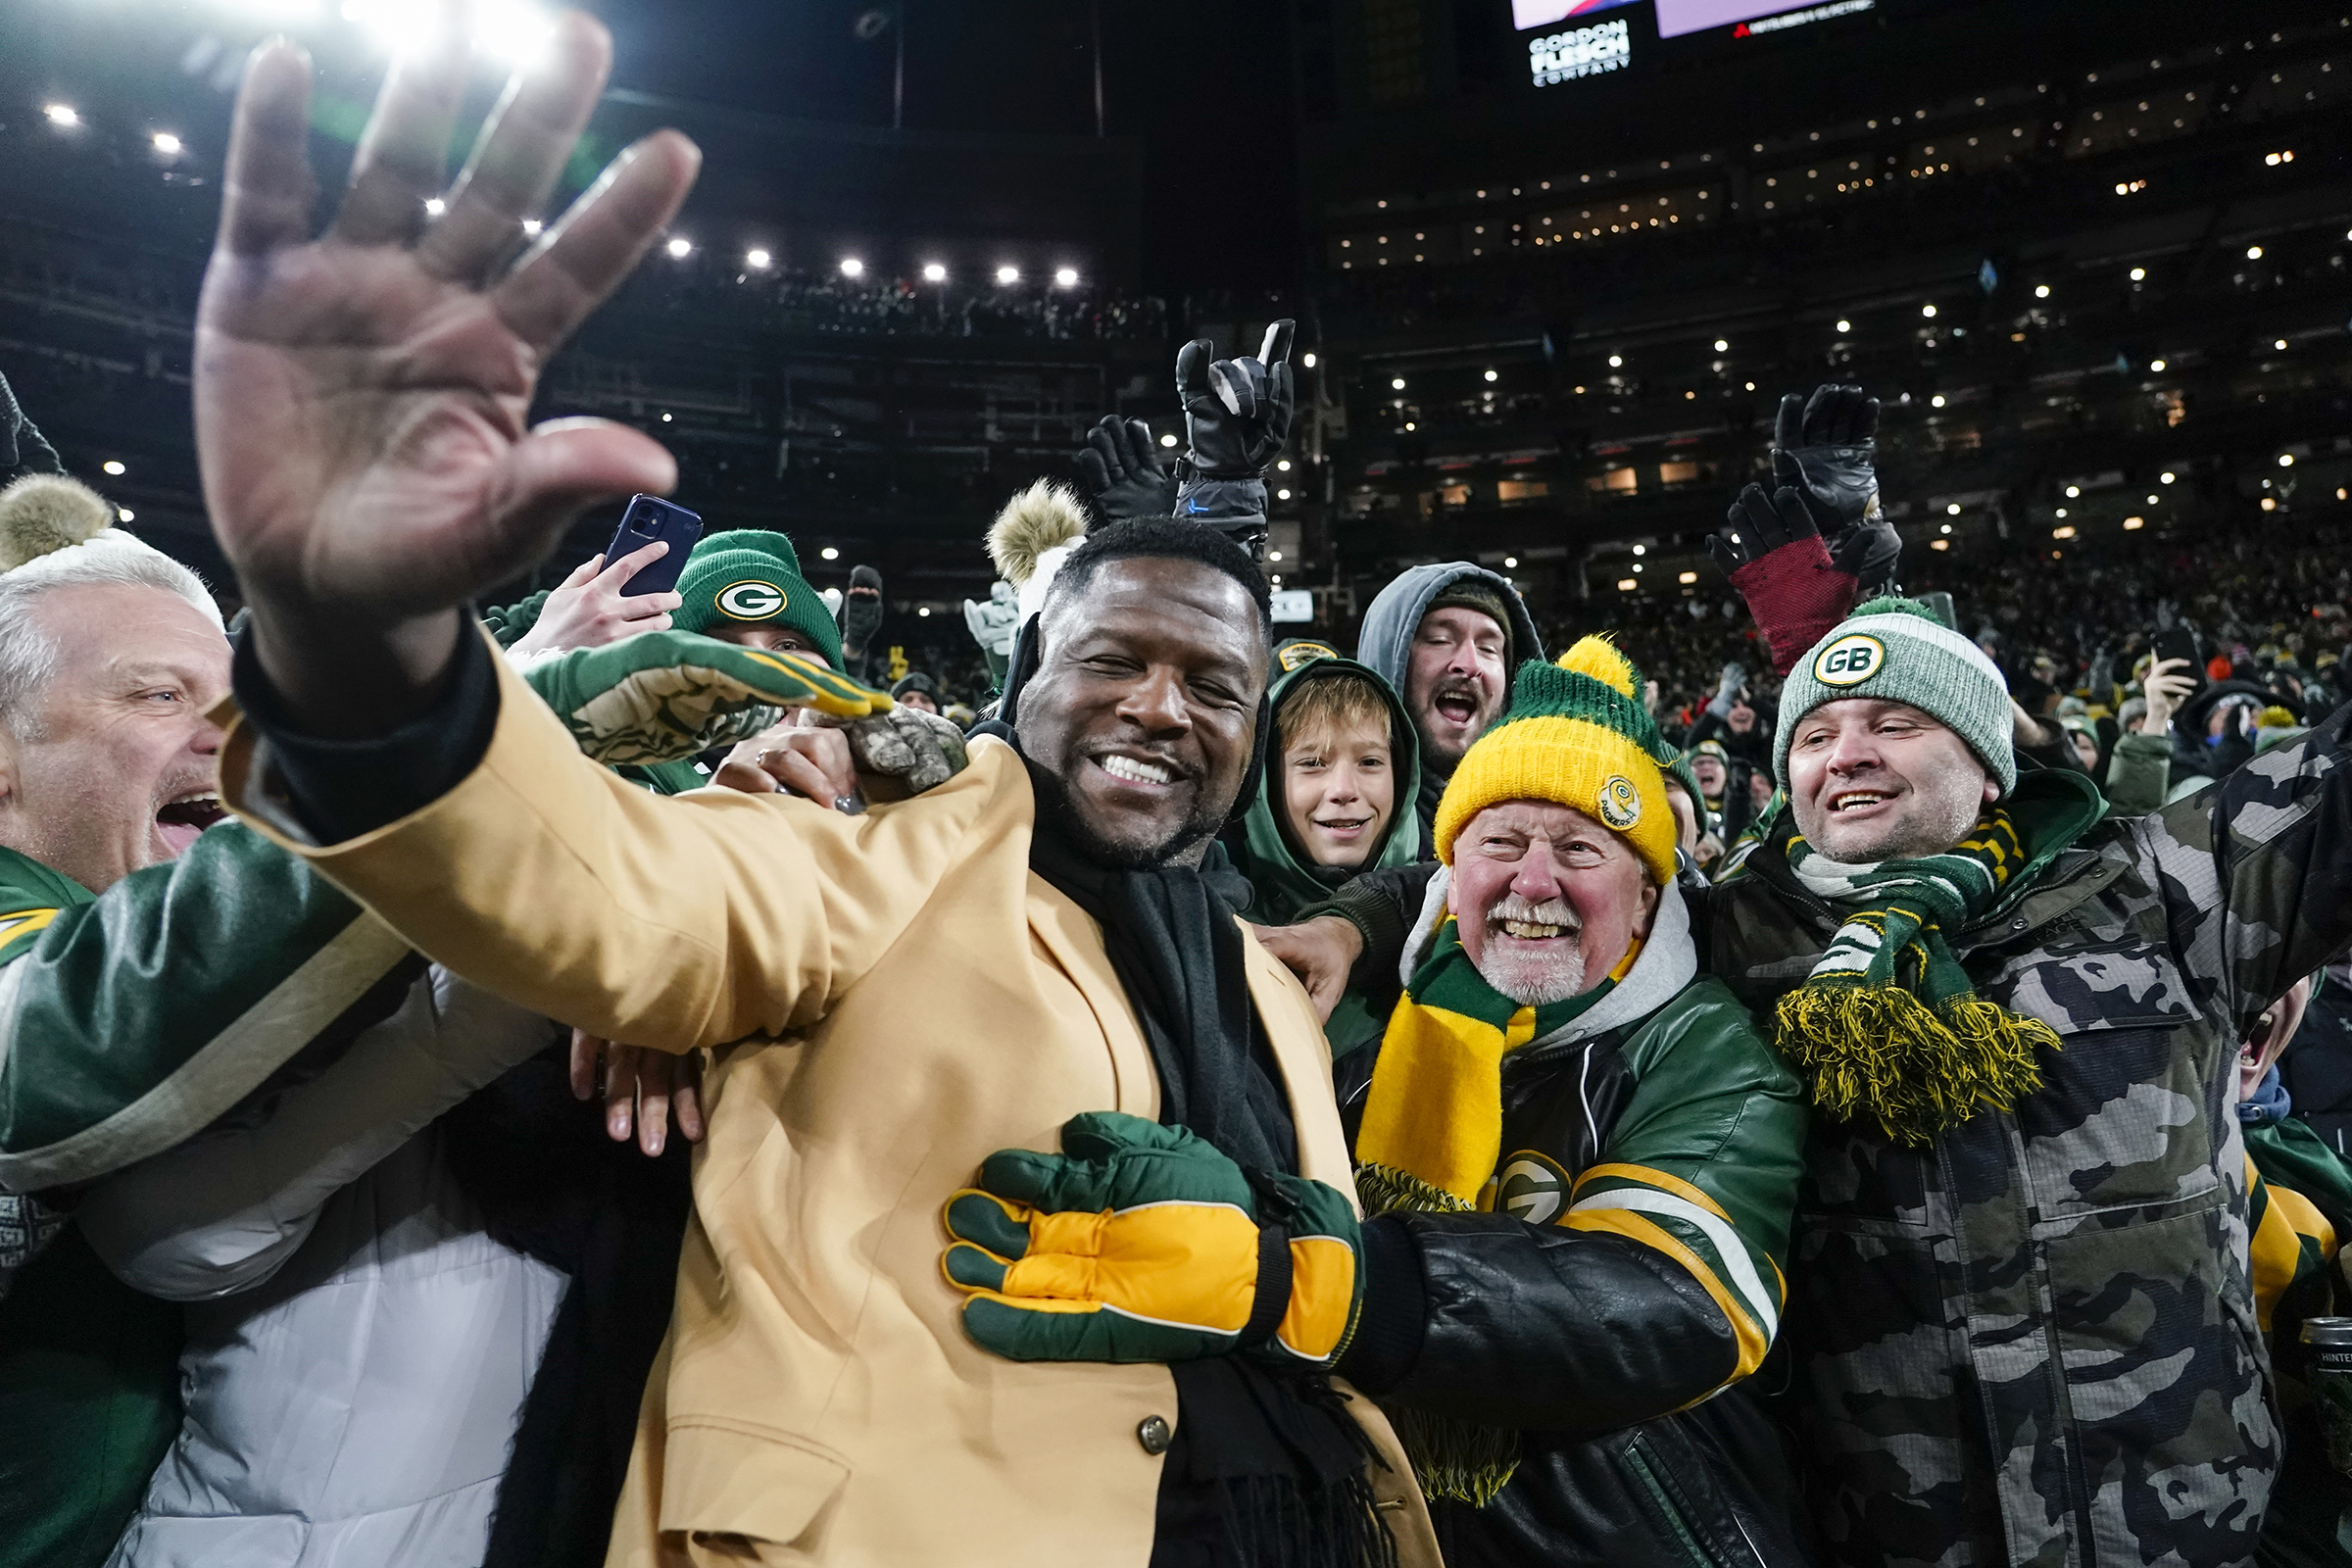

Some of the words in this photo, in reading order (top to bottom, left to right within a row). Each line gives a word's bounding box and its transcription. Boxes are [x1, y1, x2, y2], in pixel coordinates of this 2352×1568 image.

[1529, 19, 1628, 55] GORDON
[721, 584, 781, 615] G
[1825, 647, 1872, 673] GB
[1601, 800, 1631, 826] PACKERS
[2322, 1352, 2352, 1363] HINTE
